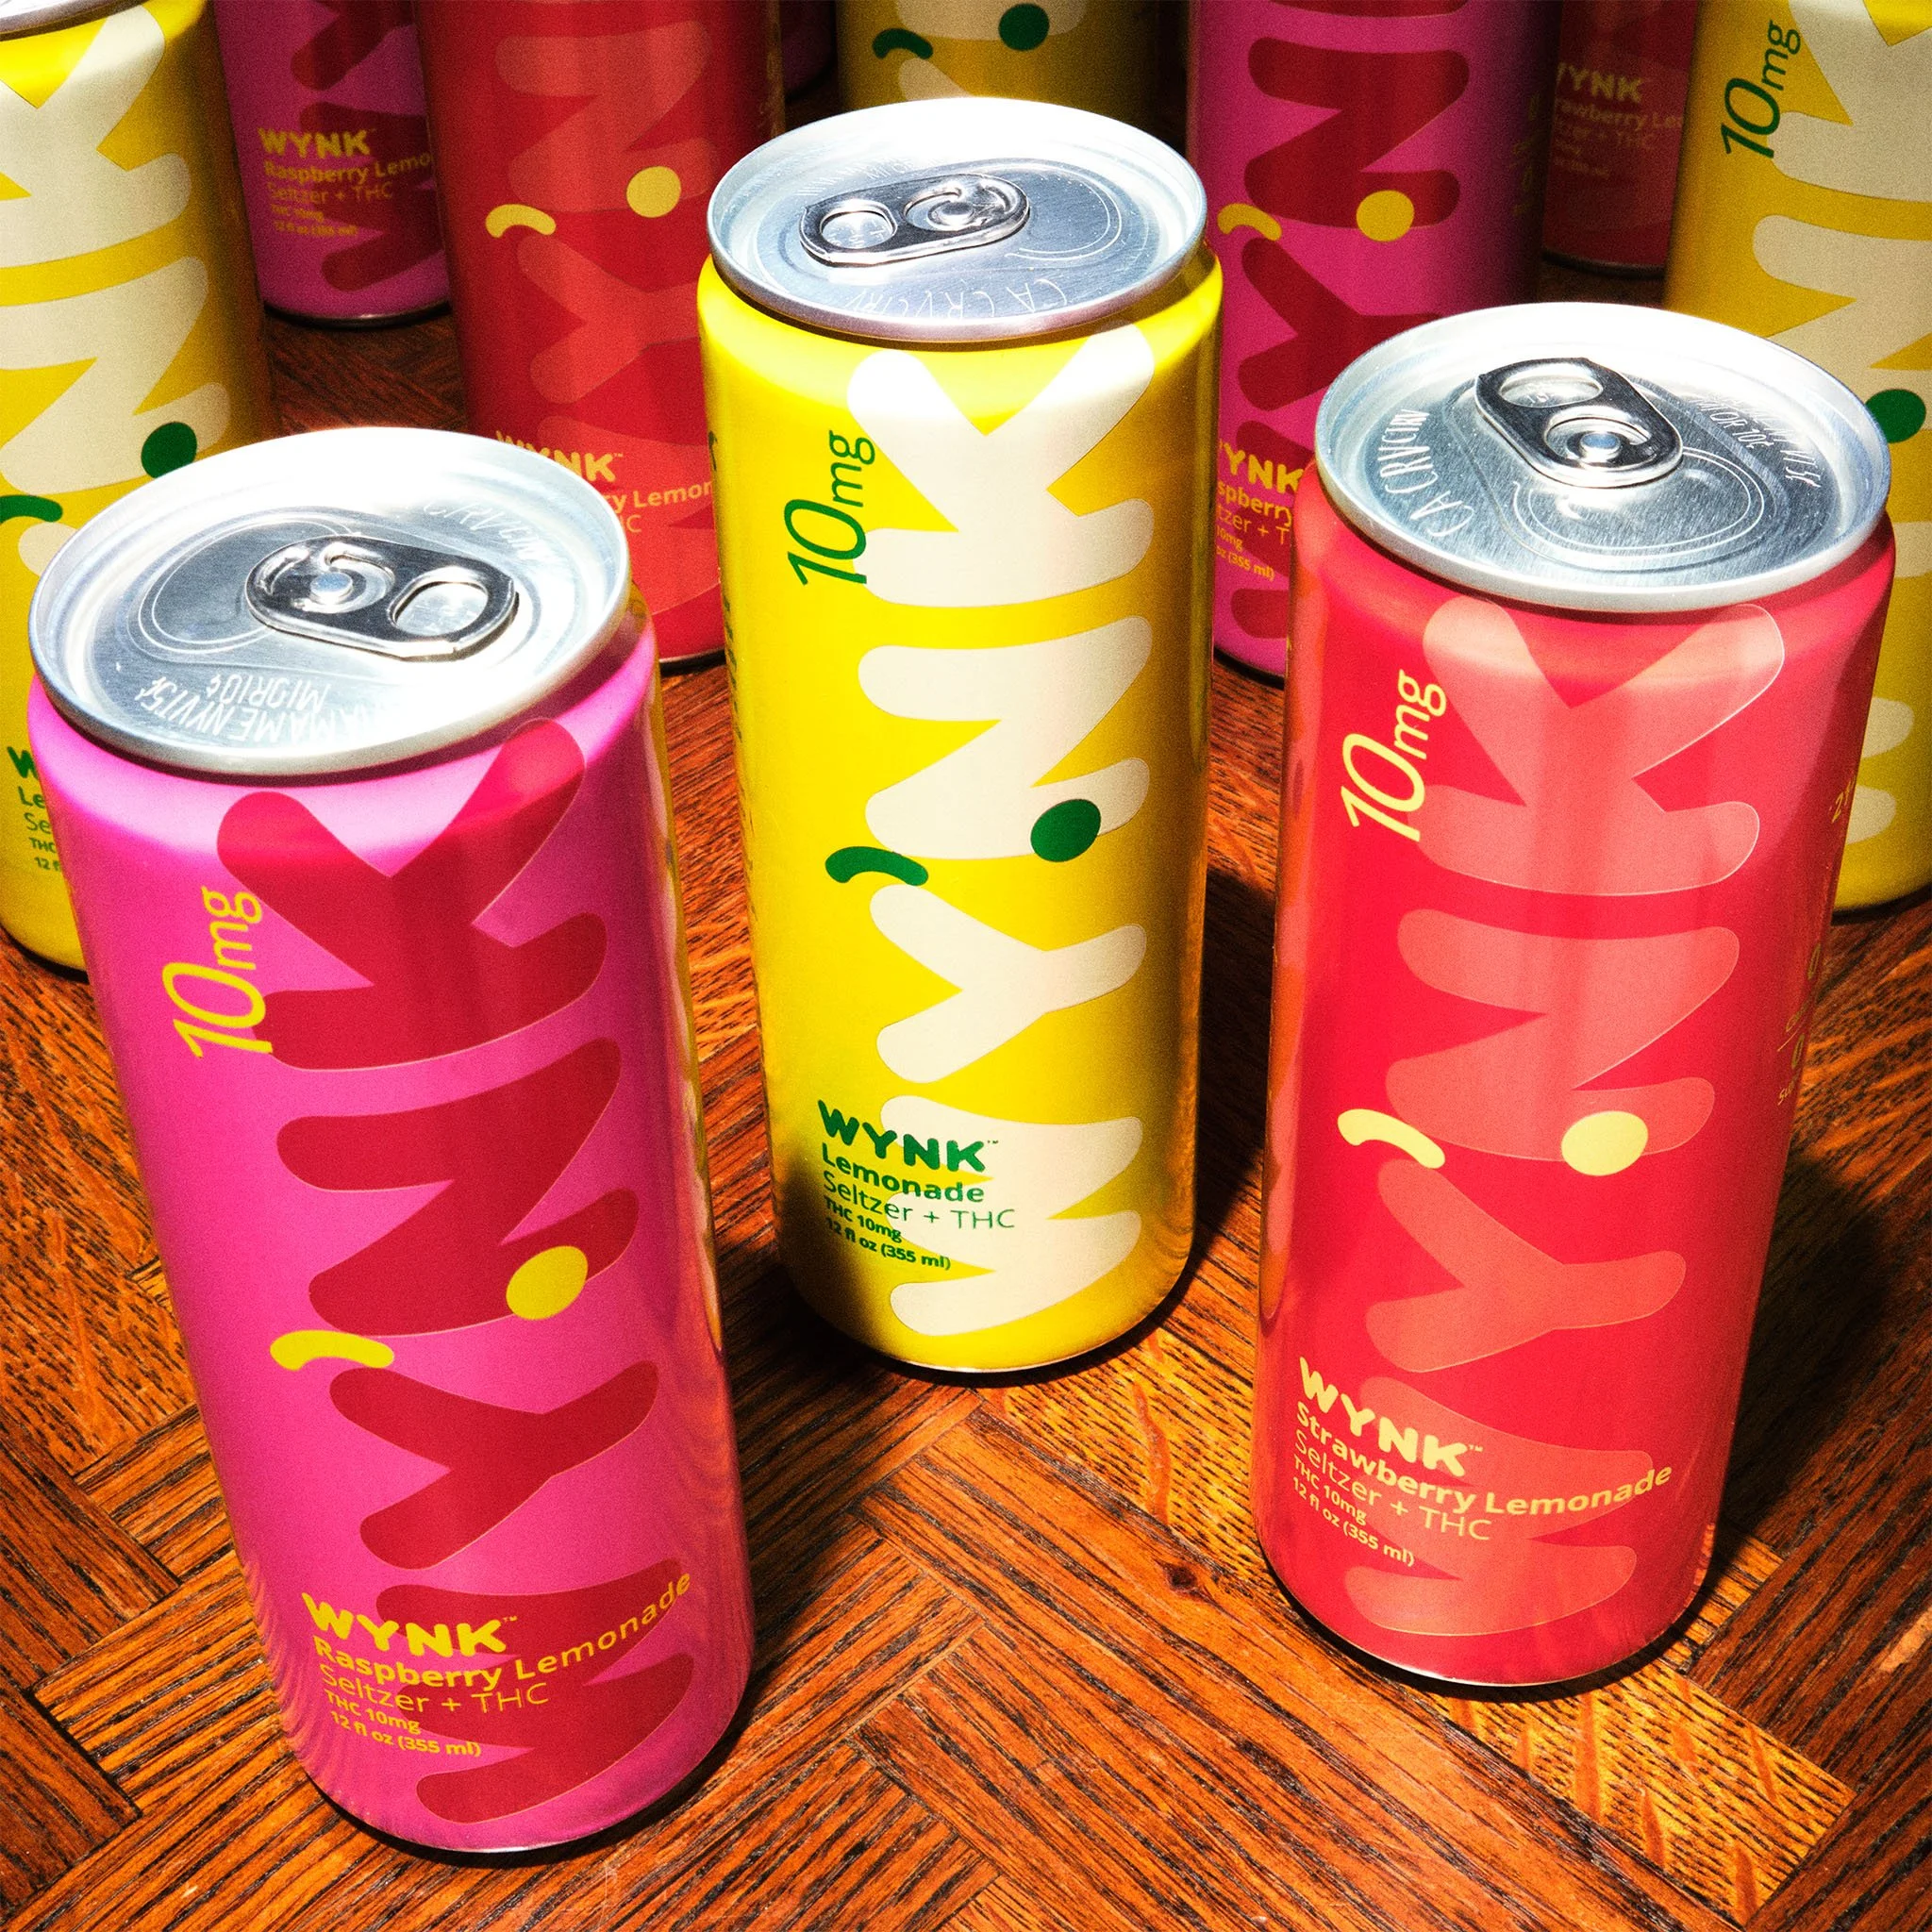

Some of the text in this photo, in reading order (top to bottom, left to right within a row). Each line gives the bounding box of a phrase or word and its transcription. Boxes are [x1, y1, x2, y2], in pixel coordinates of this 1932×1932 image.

[1557, 61, 1643, 103] YNK
[1721, 20, 1801, 158] 10mg
[1219, 438, 1305, 494] YNK
[784, 429, 876, 586] 10mg
[1341, 669, 1447, 842] 10mg
[162, 885, 274, 1058] 10mg
[822, 1142, 985, 1203] Lemonade
[824, 1171, 1016, 1229] Seltzer + THC
[824, 1194, 903, 1243] THC 10mg
[825, 1217, 952, 1272] 12 fl oz (355 ml)
[1293, 1454, 1367, 1526] THC 10mg
[1294, 1429, 1492, 1541] Seltzer + THC
[1296, 1401, 1673, 1515] Strawberry Lemonade
[1292, 1476, 1415, 1567] 12 fl oz (355 ml)
[312, 1573, 691, 1691] Raspberry Lemonade
[319, 1663, 549, 1713] Seltzer + THC
[324, 1689, 422, 1735] THC 10mg
[330, 1710, 481, 1757] 12 fl oz (355 ml)
